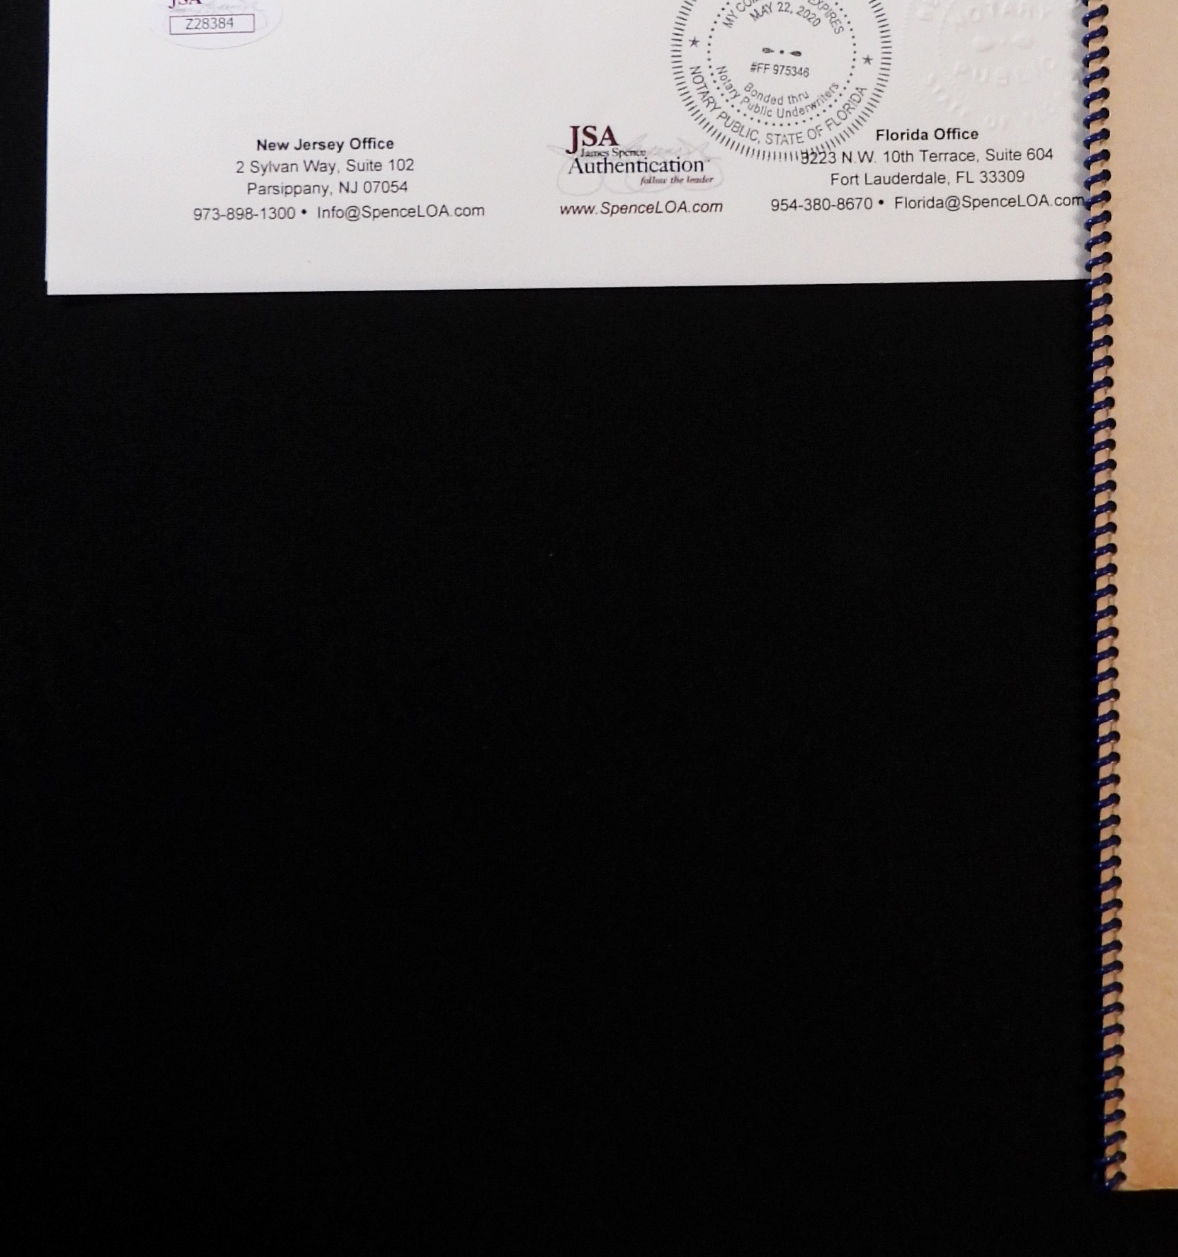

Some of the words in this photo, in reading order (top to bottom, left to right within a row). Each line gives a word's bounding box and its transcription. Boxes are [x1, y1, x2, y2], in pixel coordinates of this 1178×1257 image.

[722, 10, 739, 29] MY
[750, 2, 773, 22] MAY
[796, 5, 821, 27] 2020
[185, 17, 234, 31] Z28384
[690, 66, 719, 113] NOTARY
[719, 111, 761, 144] PUBLIC,
[765, 132, 803, 145] STATE
[806, 125, 823, 140] OF
[825, 85, 867, 128] FLORIDA
[566, 125, 620, 155] JSA
[876, 128, 929, 141] Florida
[934, 127, 979, 140] Office
[257, 139, 290, 151] New
[294, 138, 345, 153] Jersey
[349, 137, 394, 150] Office
[883, 150, 914, 163] 10th
[919, 149, 979, 163] Terrace,
[985, 148, 1022, 161] Suite
[1027, 148, 1053, 161] 604
[236, 161, 244, 173] 2
[250, 160, 298, 176] Sylvan
[303, 160, 340, 175] Way,
[346, 159, 382, 172] Suite
[388, 158, 414, 171] 102
[568, 157, 704, 175] Authentication
[831, 173, 859, 186] Fort
[865, 171, 950, 186] Lauderdale,
[956, 171, 974, 184] FL
[979, 170, 1025, 183] 33309
[247, 182, 332, 197] Parsippany,
[339, 181, 358, 194] NJ
[363, 181, 408, 194] 07054
[193, 206, 296, 221] 973-898-1300
[318, 204, 485, 222] Info@SpenceLOA.com
[560, 200, 723, 217] www.SpenceLOA.com
[771, 197, 873, 212] 954-380-8670
